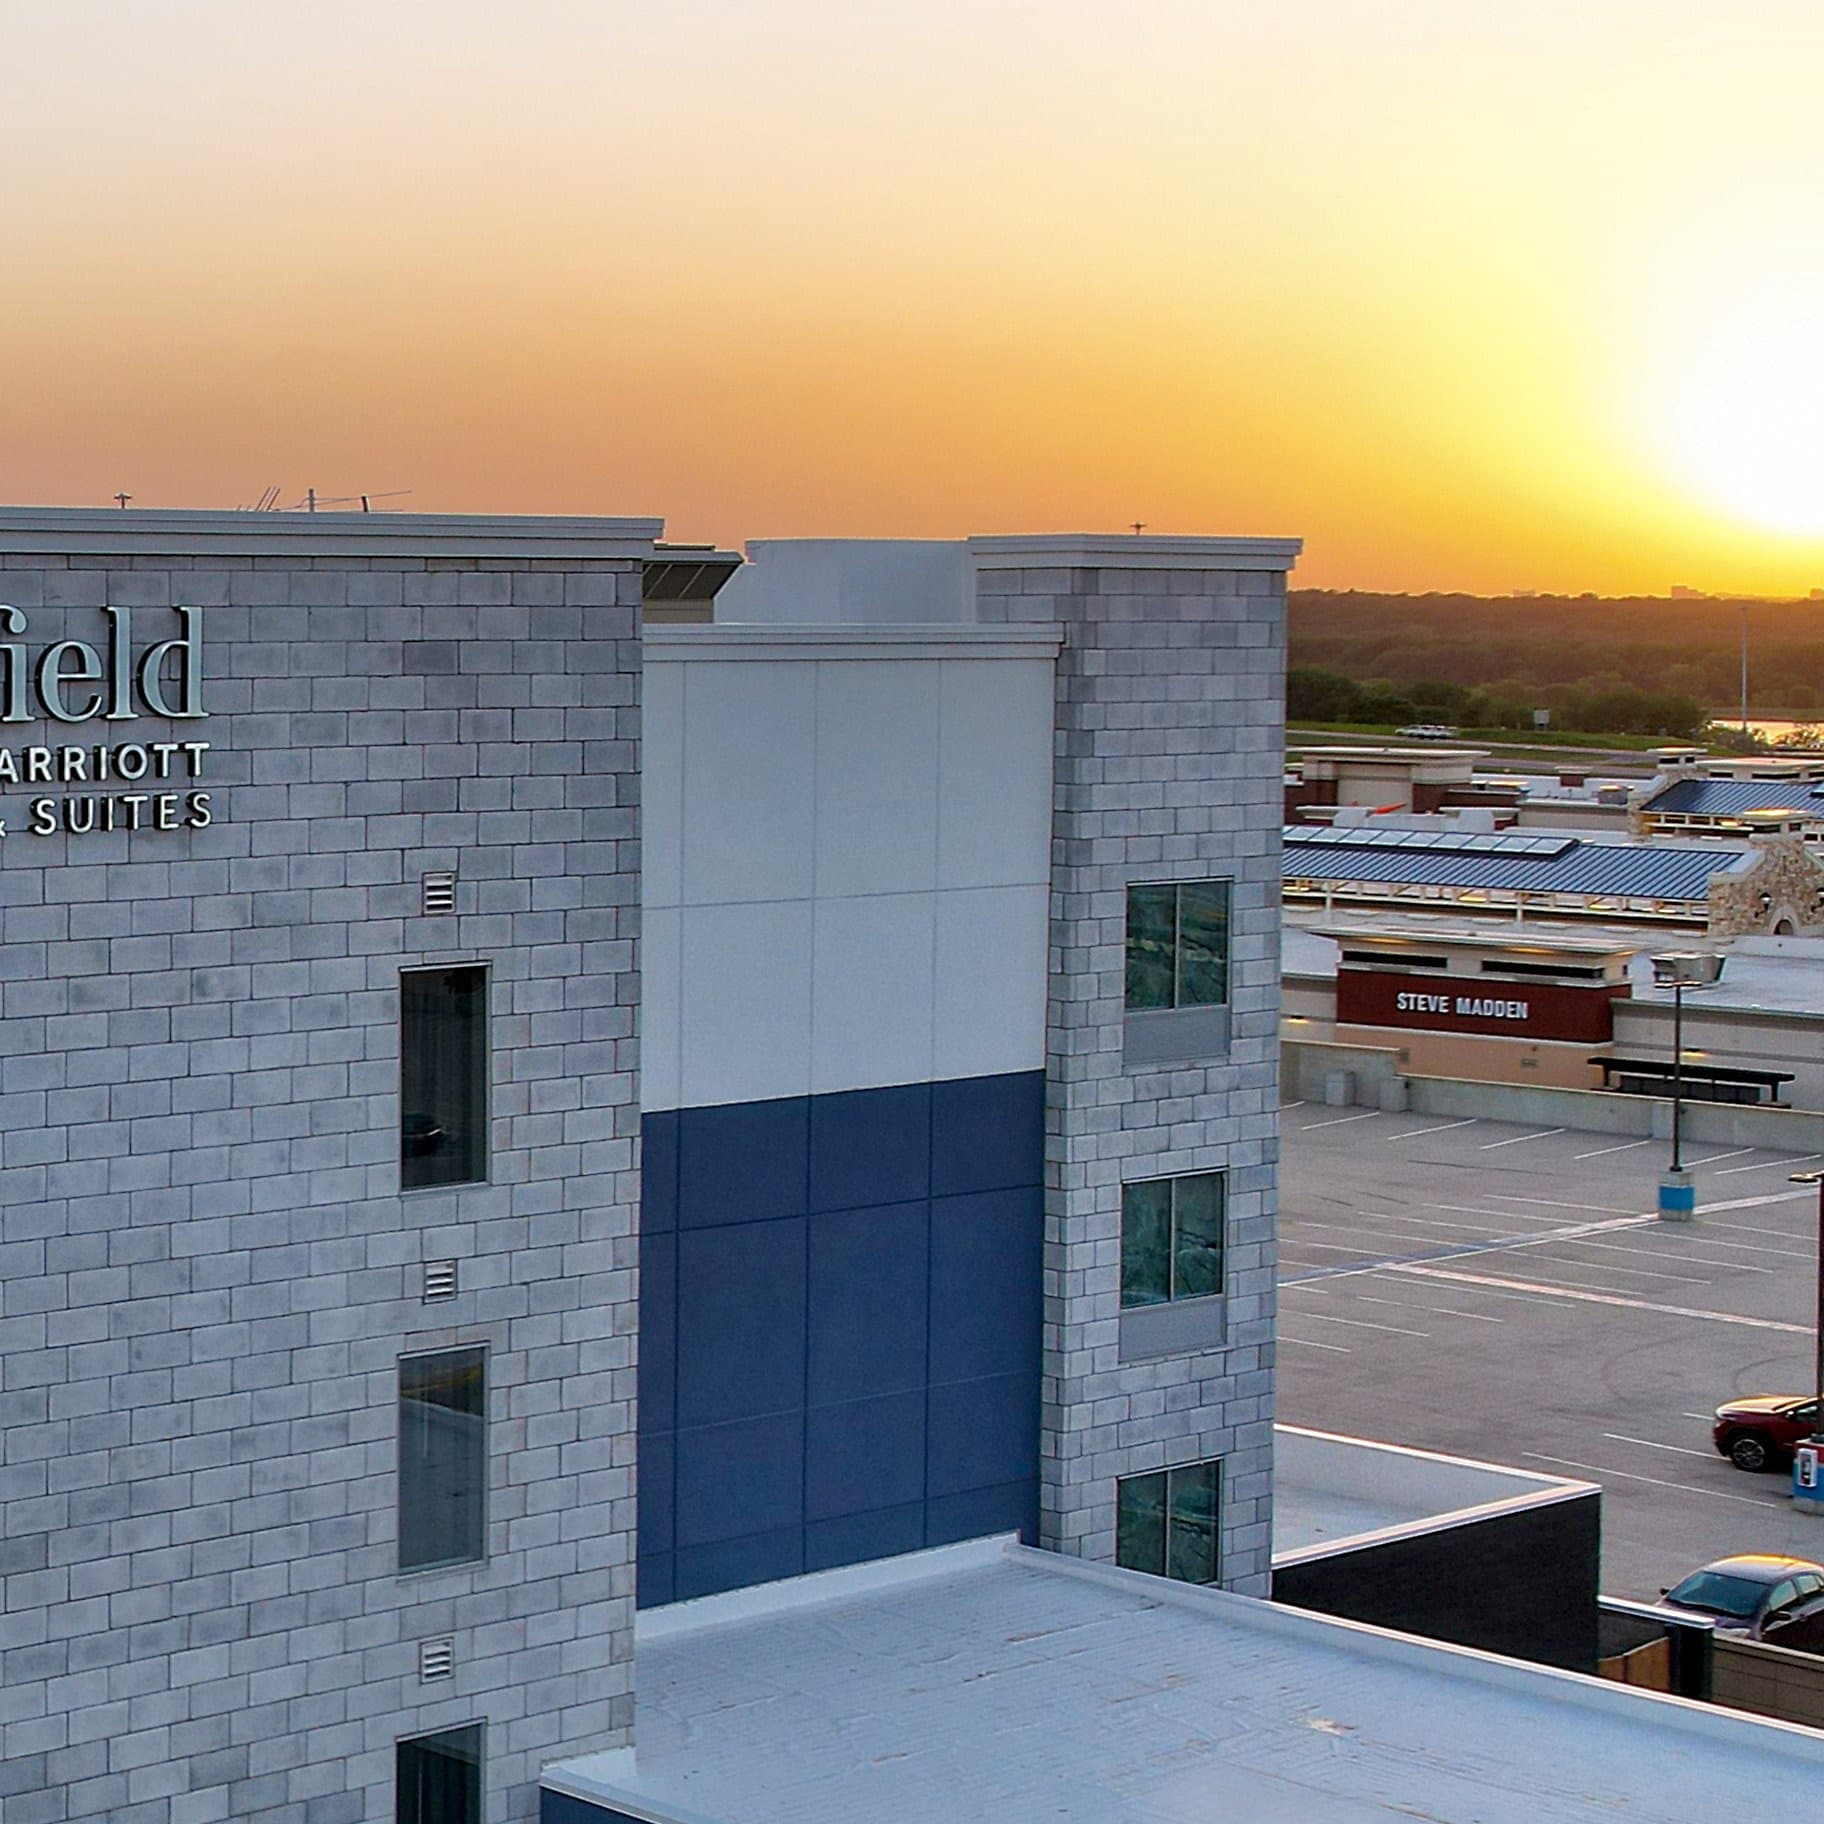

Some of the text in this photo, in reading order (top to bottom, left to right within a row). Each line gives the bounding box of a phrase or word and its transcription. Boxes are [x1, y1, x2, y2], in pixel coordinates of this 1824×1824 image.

[31, 792, 213, 835] SUITES
[1397, 992, 1528, 1019] STEVE MADDEN
